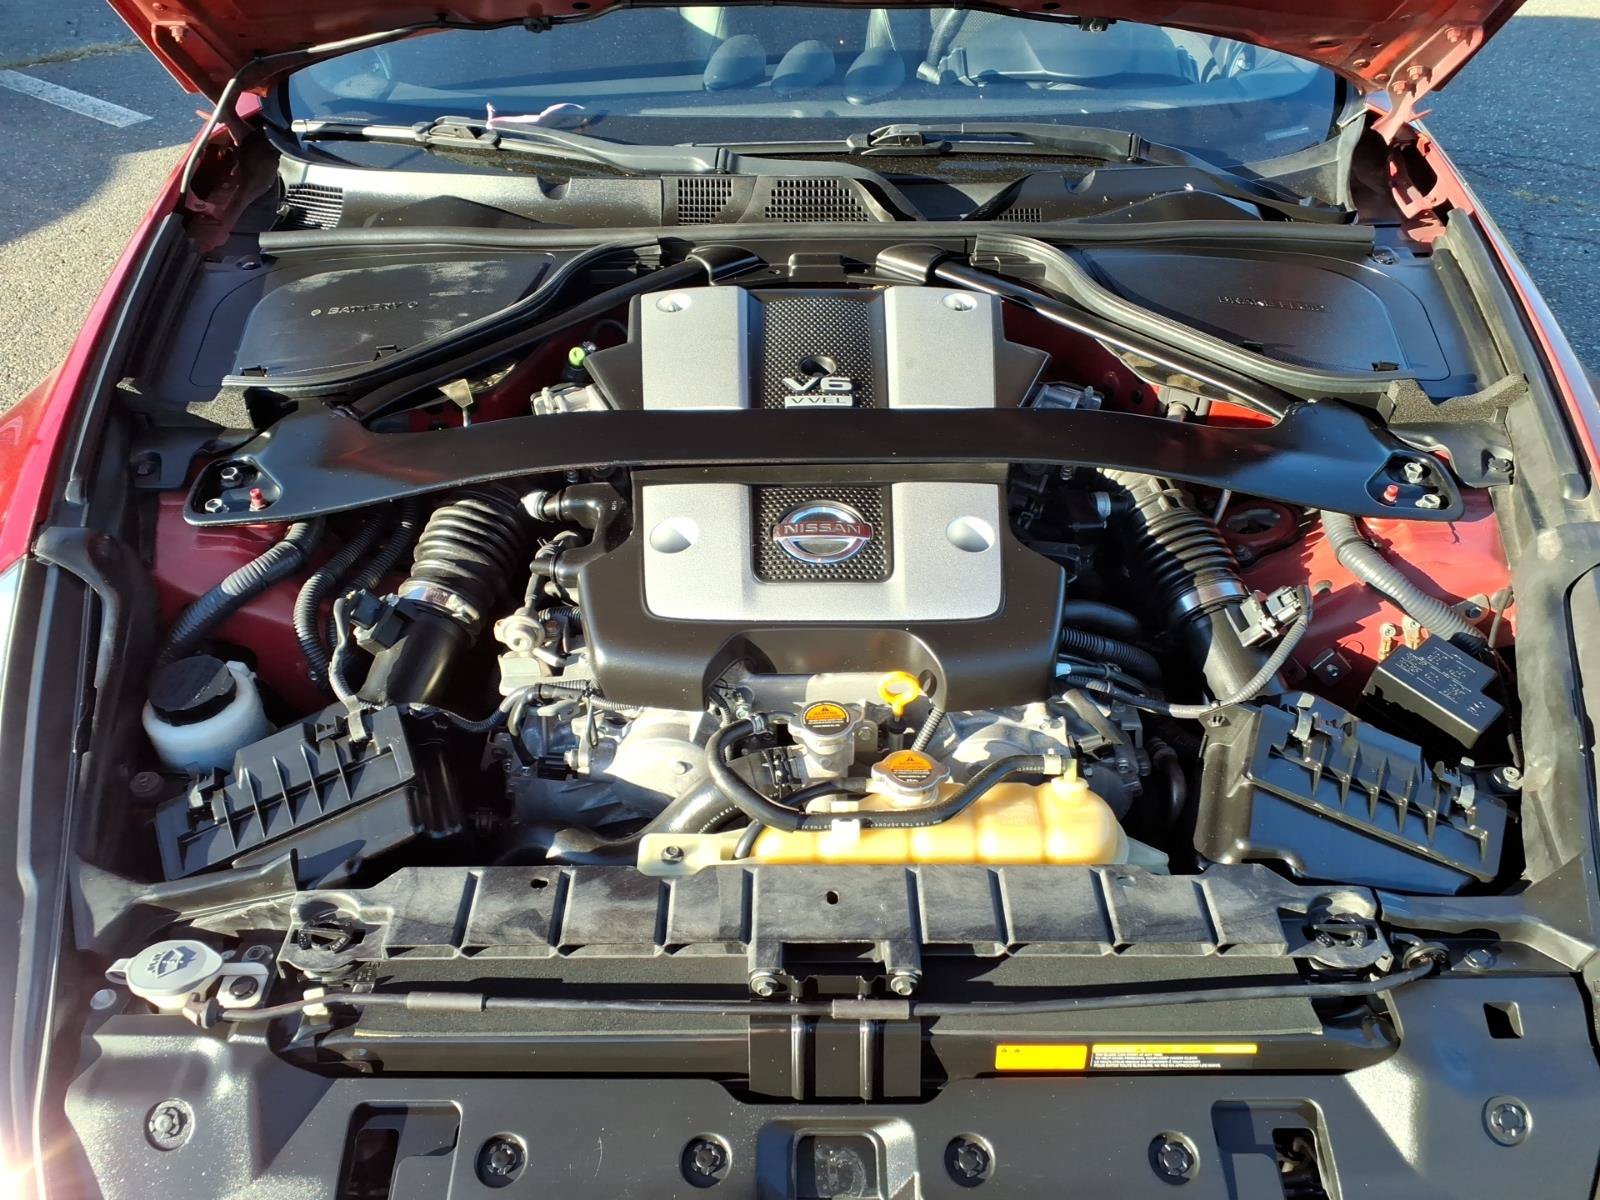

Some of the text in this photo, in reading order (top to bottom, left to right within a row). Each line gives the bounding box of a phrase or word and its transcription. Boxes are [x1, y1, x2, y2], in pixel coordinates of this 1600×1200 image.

[327, 302, 403, 314] BATTERY
[782, 376, 852, 392] V6
[784, 523, 860, 534] NISSAN
